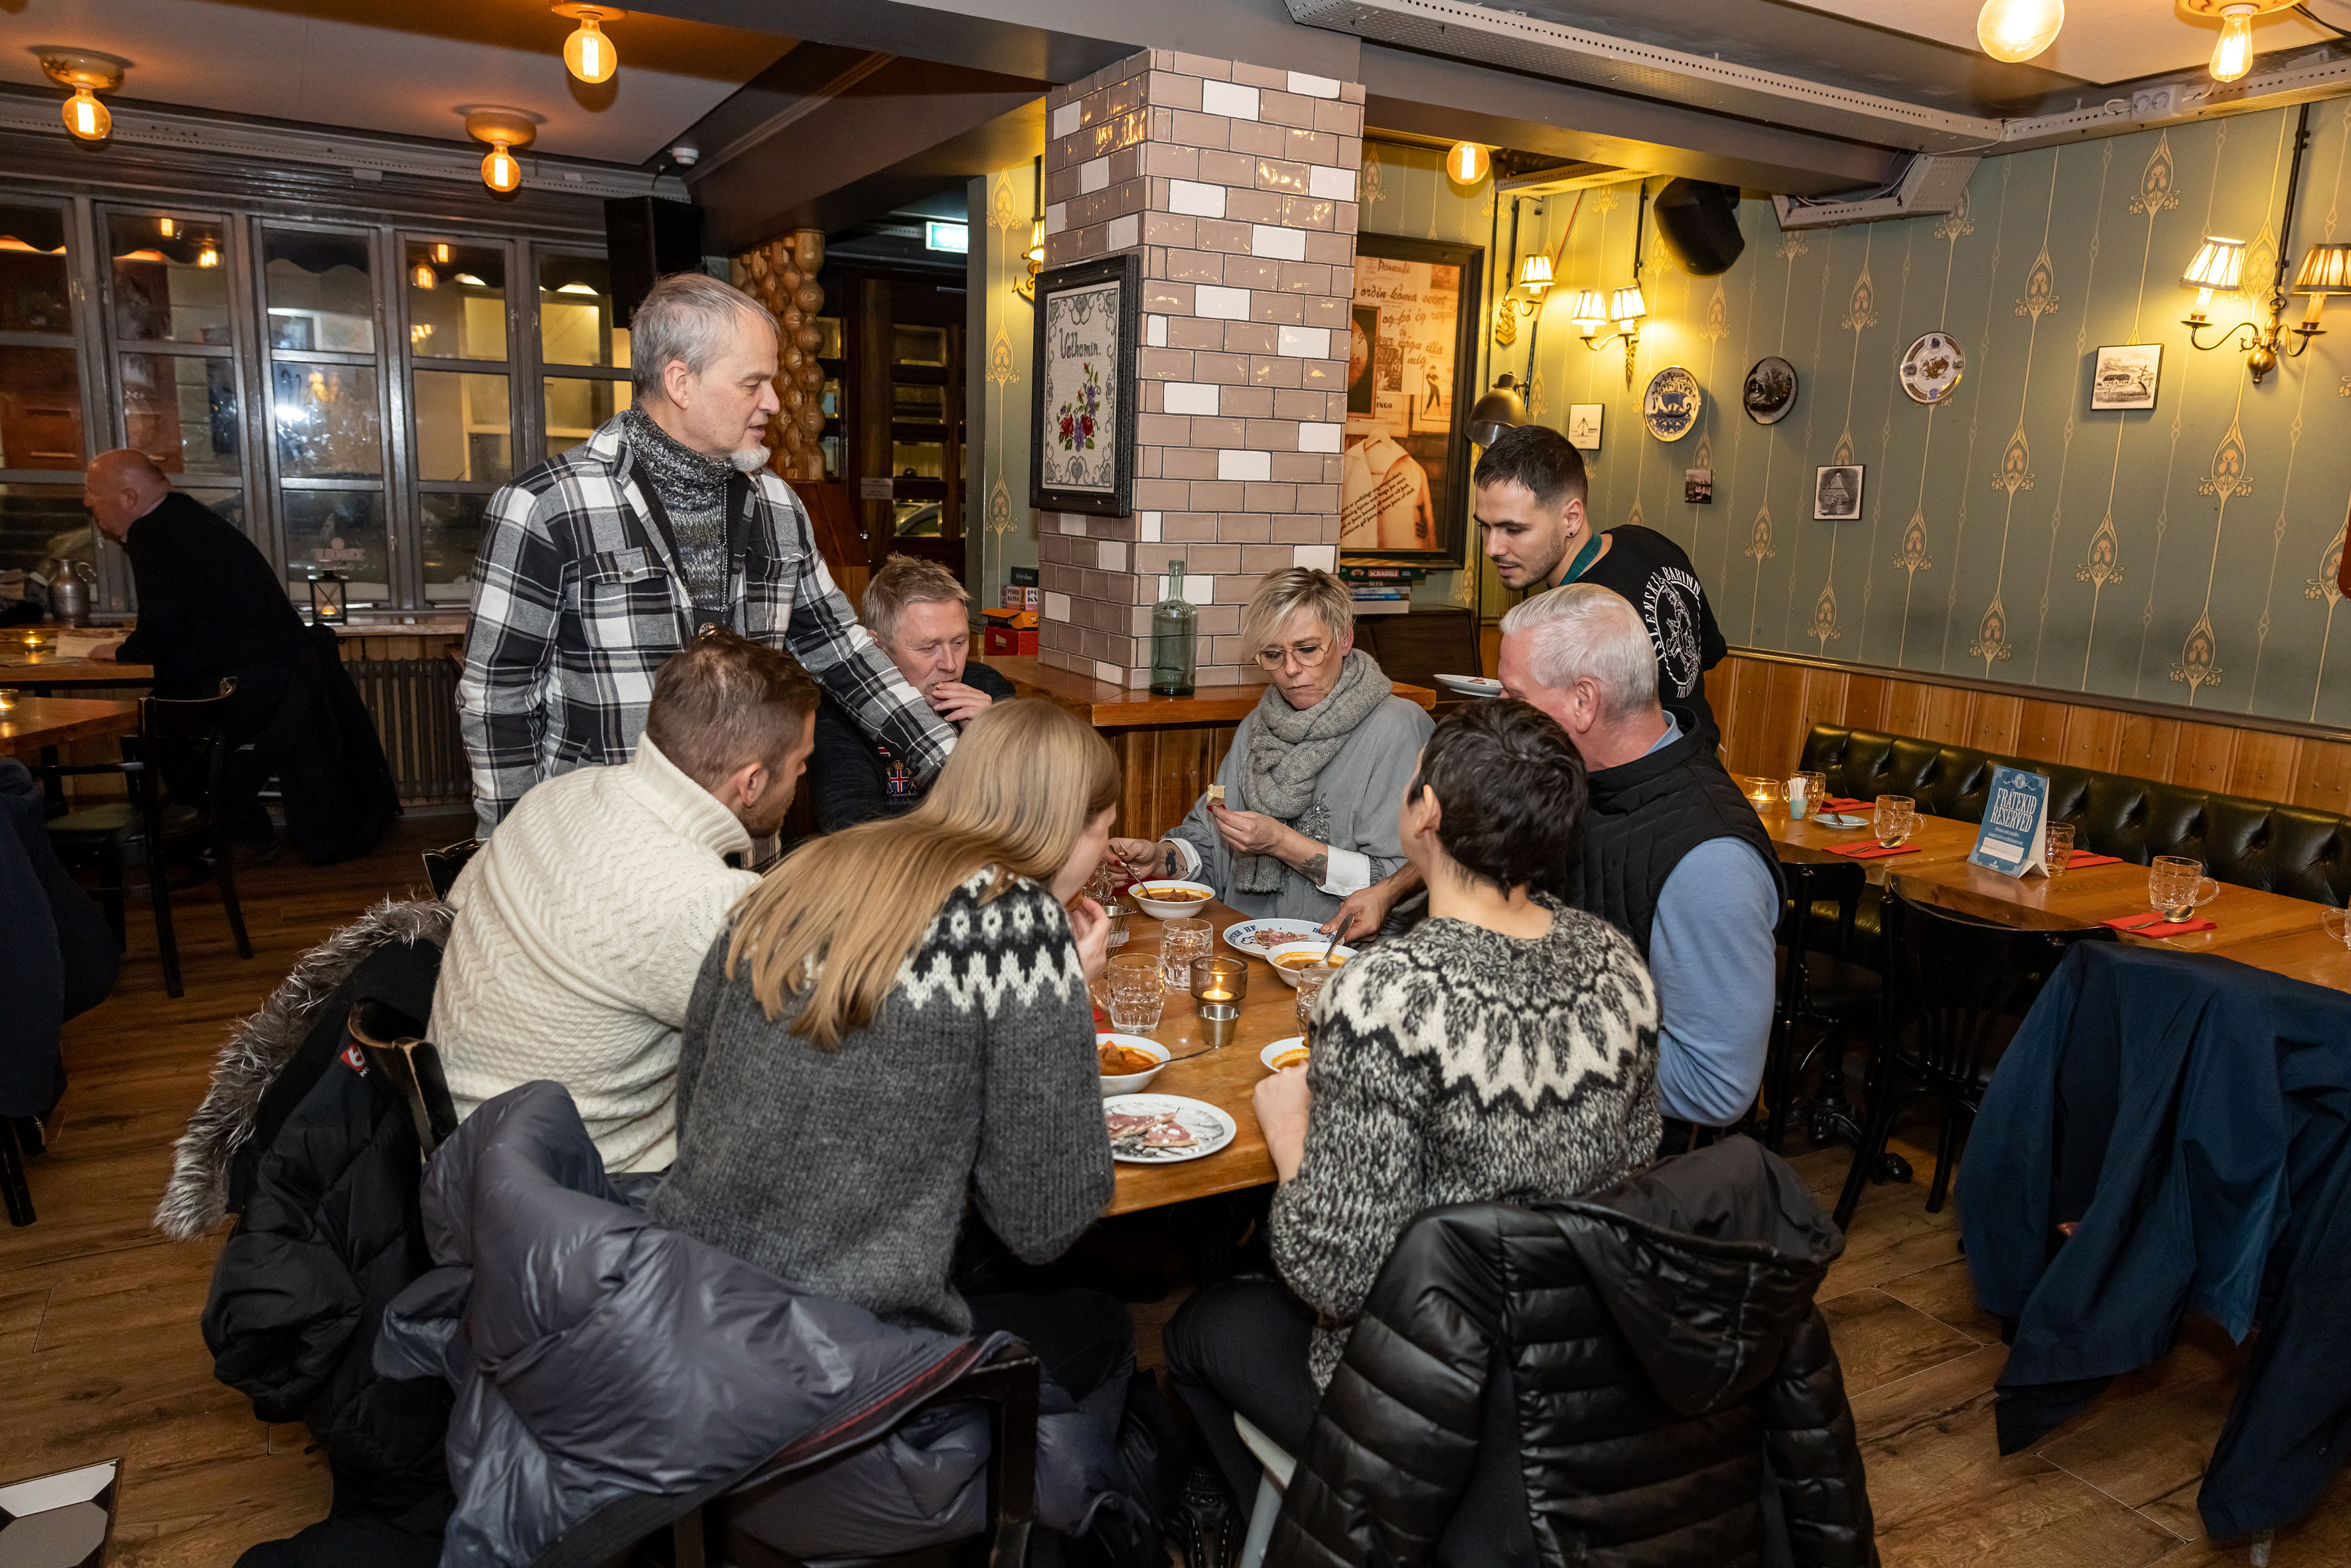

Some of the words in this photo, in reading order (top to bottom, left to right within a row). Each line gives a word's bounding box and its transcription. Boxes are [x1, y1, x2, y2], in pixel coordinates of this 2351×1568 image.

[1360, 284, 1387, 299] orðin
[1390, 287, 1417, 303] koma
[1382, 315, 1394, 328] og
[1415, 308, 1426, 326] ég
[1425, 340, 1444, 355] illa
[1661, 567, 1701, 596] BARINN
[1994, 787, 2037, 816] FRÁTEKIÐ
[1989, 805, 2032, 833] RESERVED
